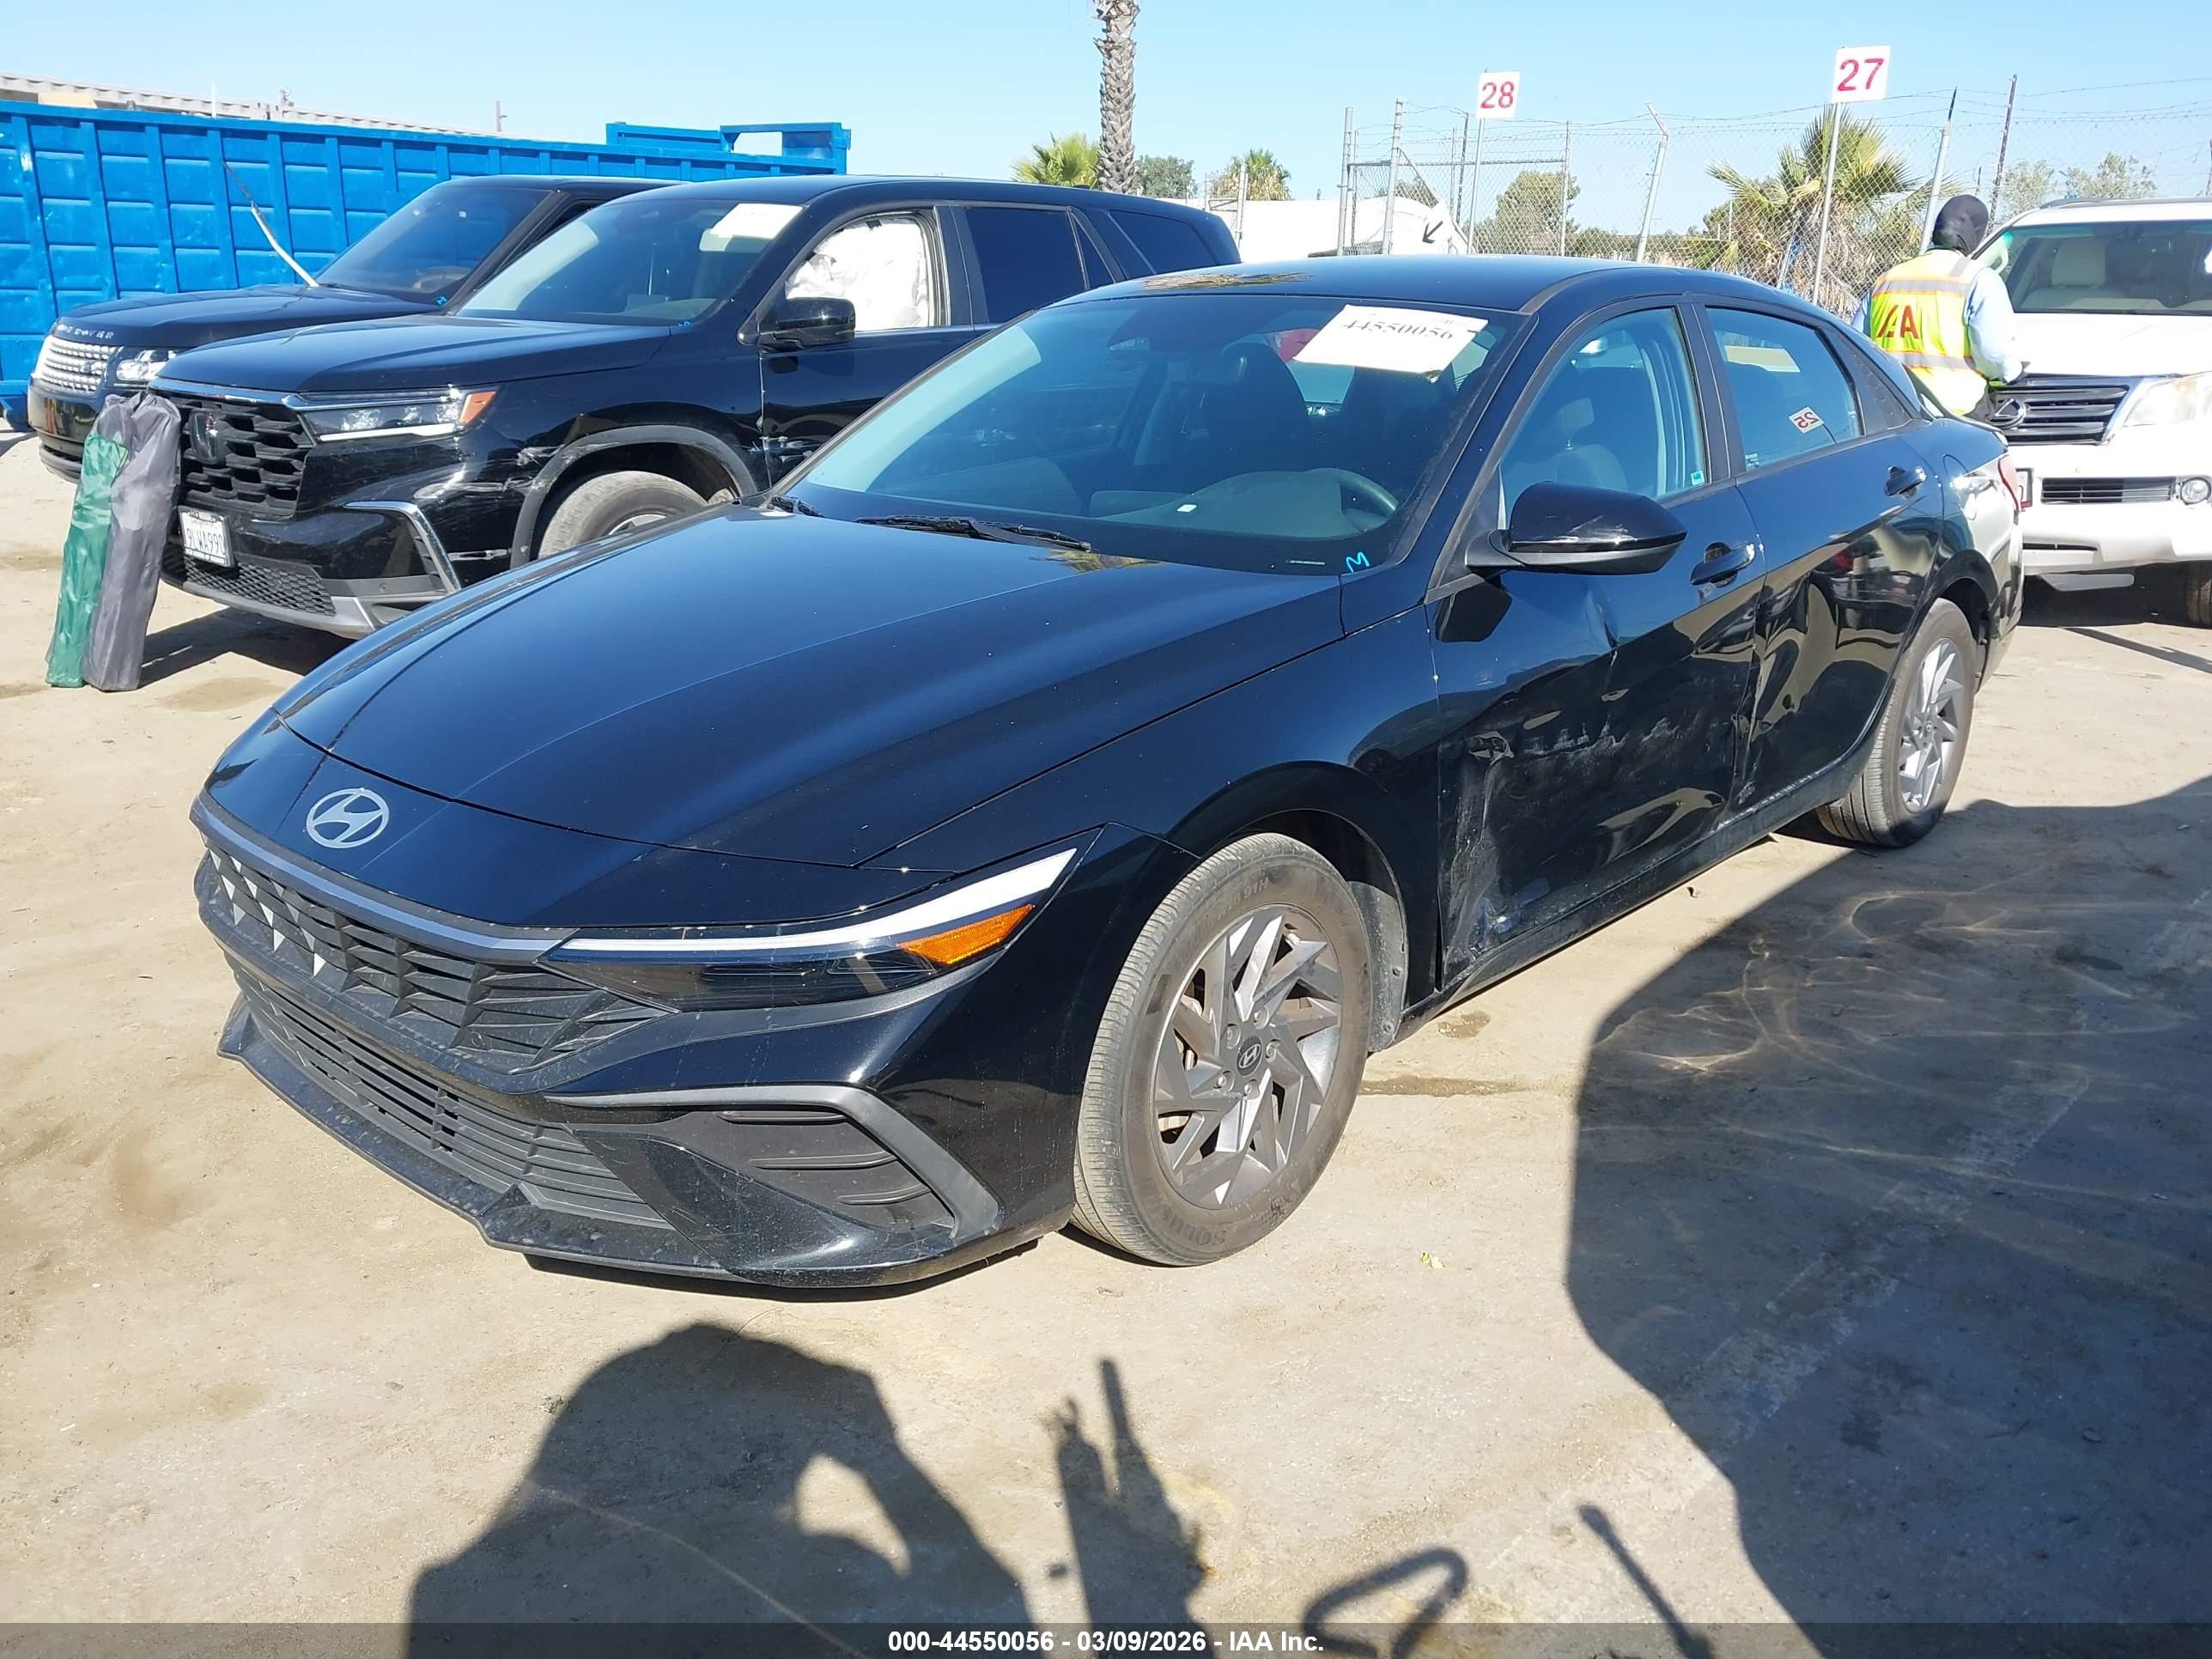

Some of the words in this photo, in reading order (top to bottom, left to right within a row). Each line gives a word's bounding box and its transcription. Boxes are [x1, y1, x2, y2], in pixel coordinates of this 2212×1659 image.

[1838, 58, 1885, 91] 27
[1480, 81, 1515, 108] 28
[1342, 319, 1454, 340] 44550056
[1346, 551, 1370, 573] M
